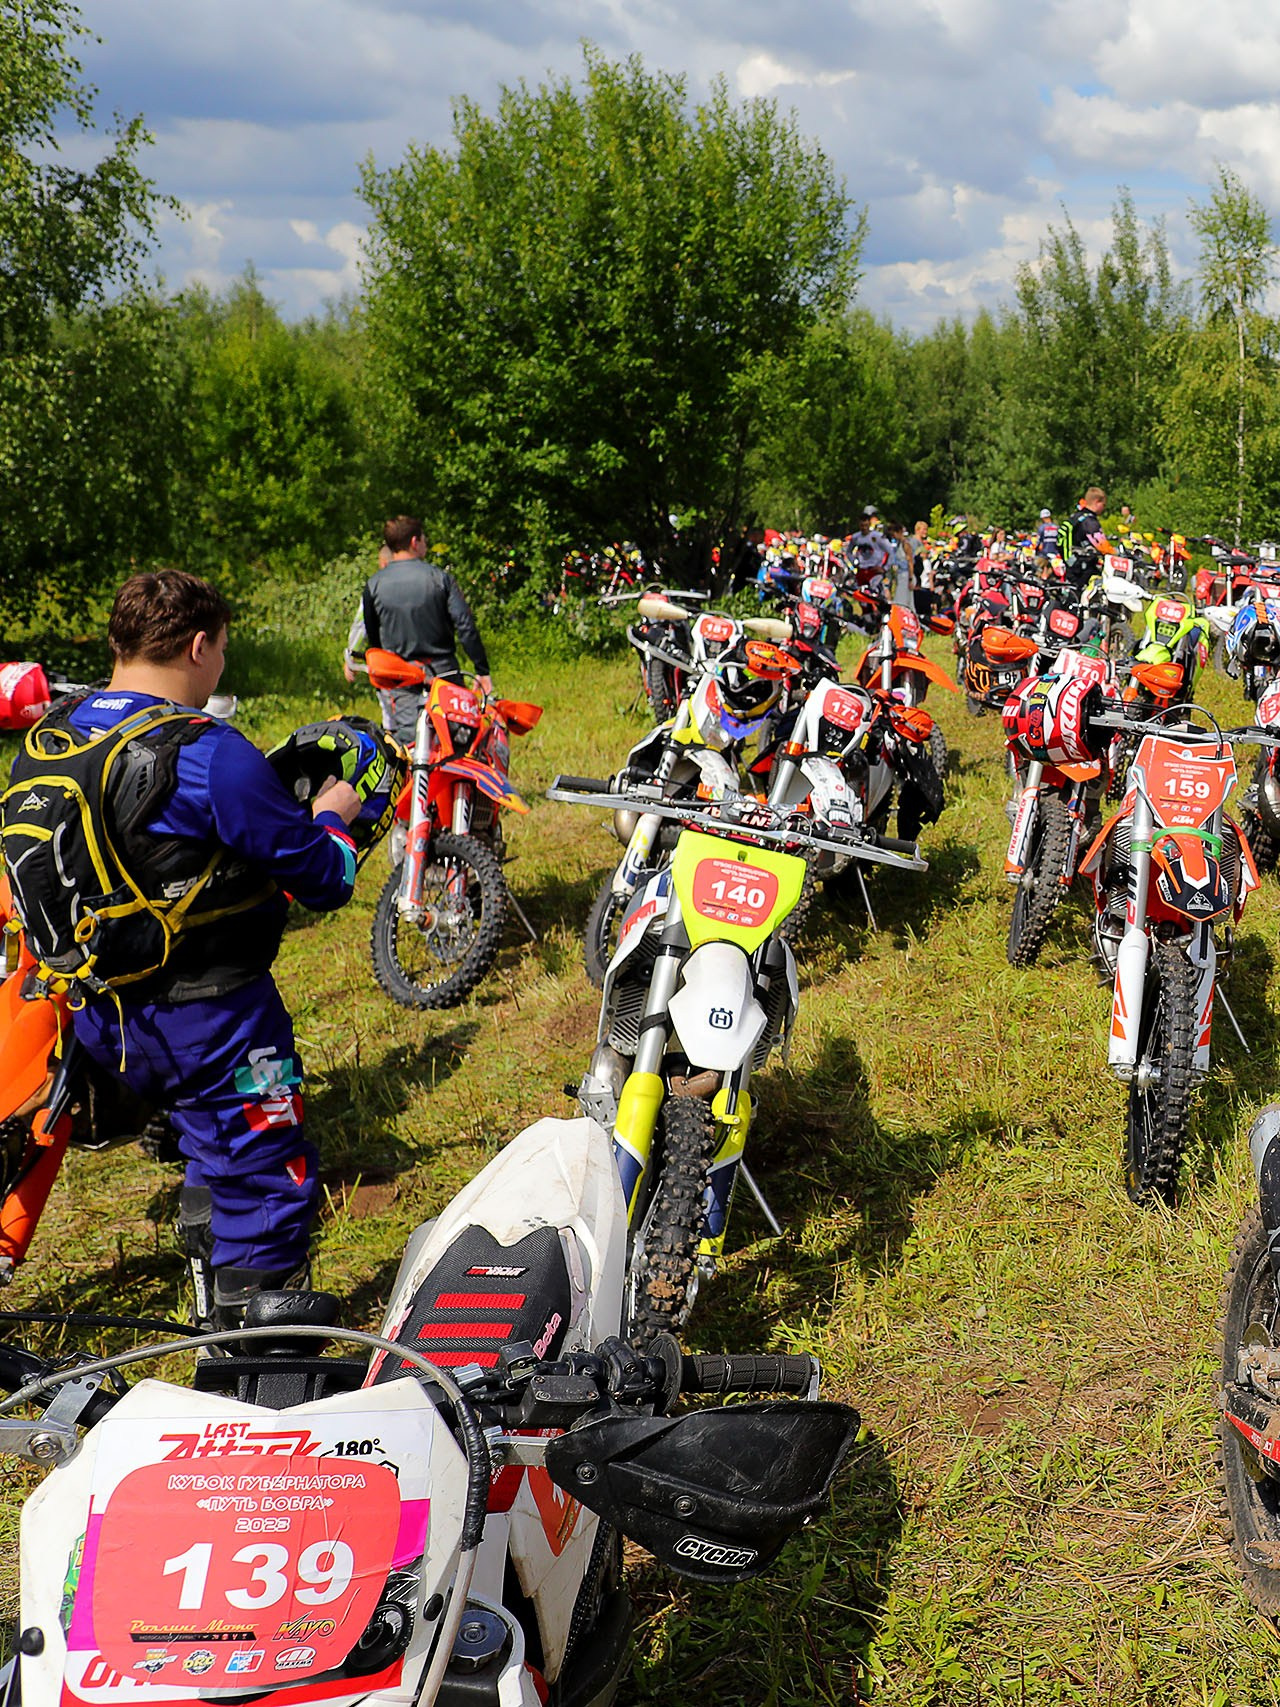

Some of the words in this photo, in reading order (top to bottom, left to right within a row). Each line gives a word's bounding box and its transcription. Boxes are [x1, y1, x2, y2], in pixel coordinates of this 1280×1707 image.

[1164, 779, 1210, 798] 159
[1171, 815, 1195, 825] KTM
[711, 880, 766, 908] 140
[533, 1313, 562, 1360] Beta
[203, 1423, 251, 1439] LAST
[168, 1475, 235, 1491] КУБОК
[237, 1474, 366, 1491] ГУБЕРНАТОРА
[196, 1496, 258, 1511] «ПУТЬ
[260, 1496, 334, 1511] БОБРА»
[234, 1517, 291, 1533] 2023
[676, 1538, 755, 1567] CYCRA
[162, 1540, 354, 1611] 139
[271, 1611, 335, 1642] KAYO
[183, 1655, 216, 1670] DRC
